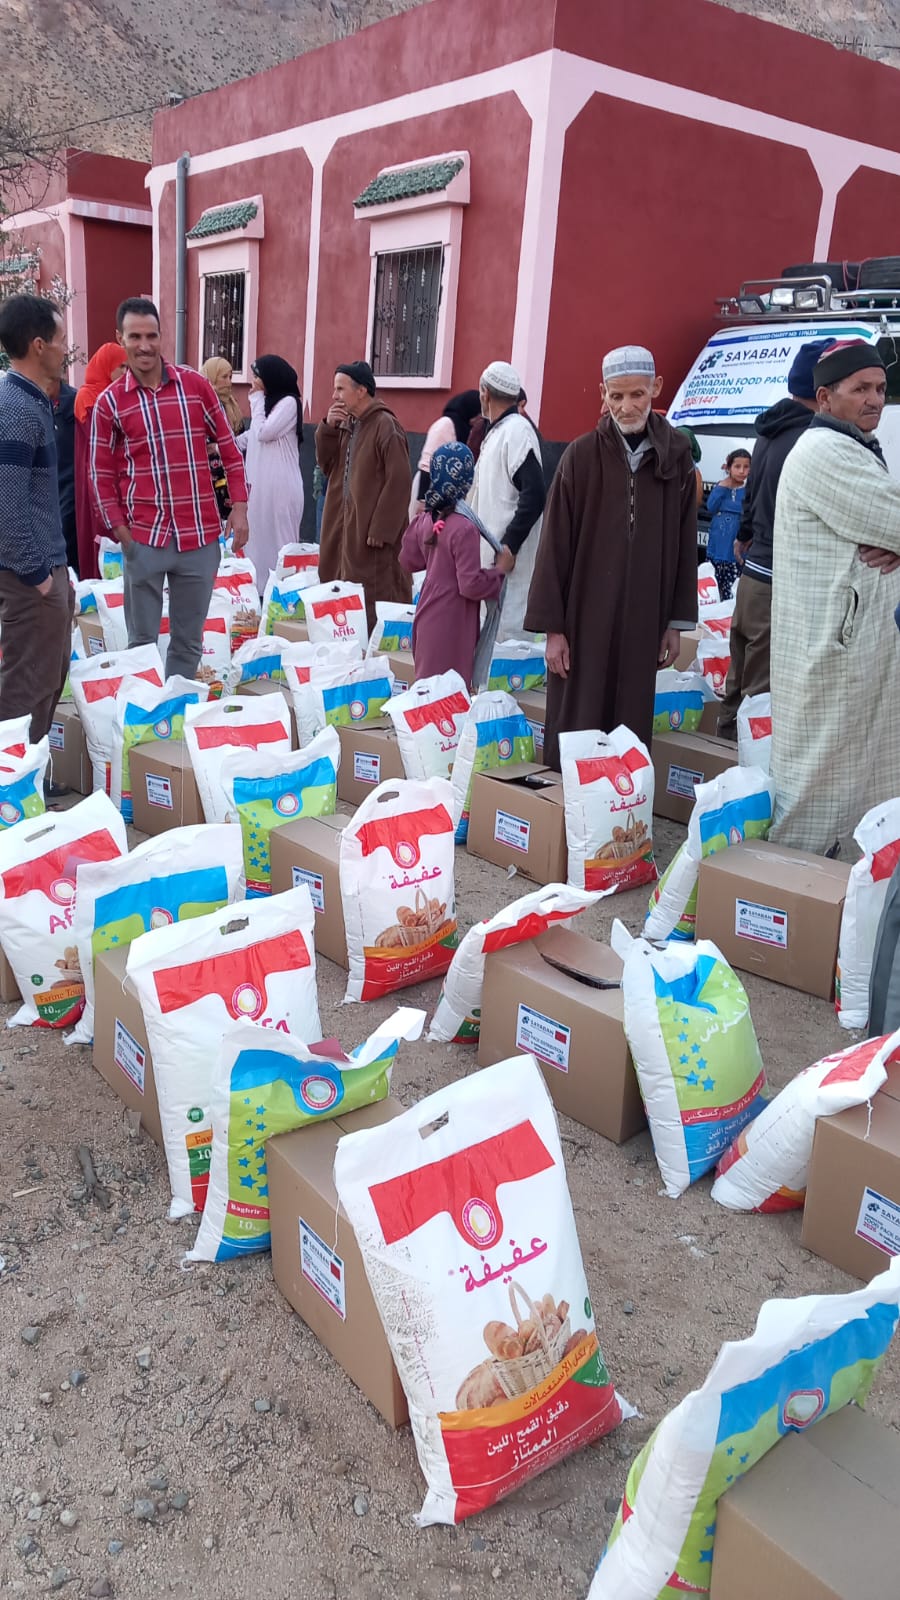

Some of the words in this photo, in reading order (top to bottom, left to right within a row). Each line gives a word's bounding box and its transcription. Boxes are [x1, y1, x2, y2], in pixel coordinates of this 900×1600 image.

[724, 346, 791, 362] SAYABAN
[686, 387, 743, 397] DISTRIBUTION
[688, 378, 733, 389] RAMADAN
[735, 376, 762, 386] FOOD
[610, 793, 647, 812] عفيفة
[389, 865, 442, 890] عفيفة
[43, 1005, 54, 1014] 10
[530, 1020, 553, 1035] SAYABAN
[684, 1109, 719, 1123] كسكس
[198, 1149, 211, 1160] 10
[460, 1237, 547, 1292] عفيفة
[574, 1346, 586, 1367] لكل
[546, 1400, 569, 1424] دقيق
[516, 1415, 543, 1443] القمح
[487, 1432, 513, 1456] اللين
[510, 1426, 557, 1470] الممتاز
